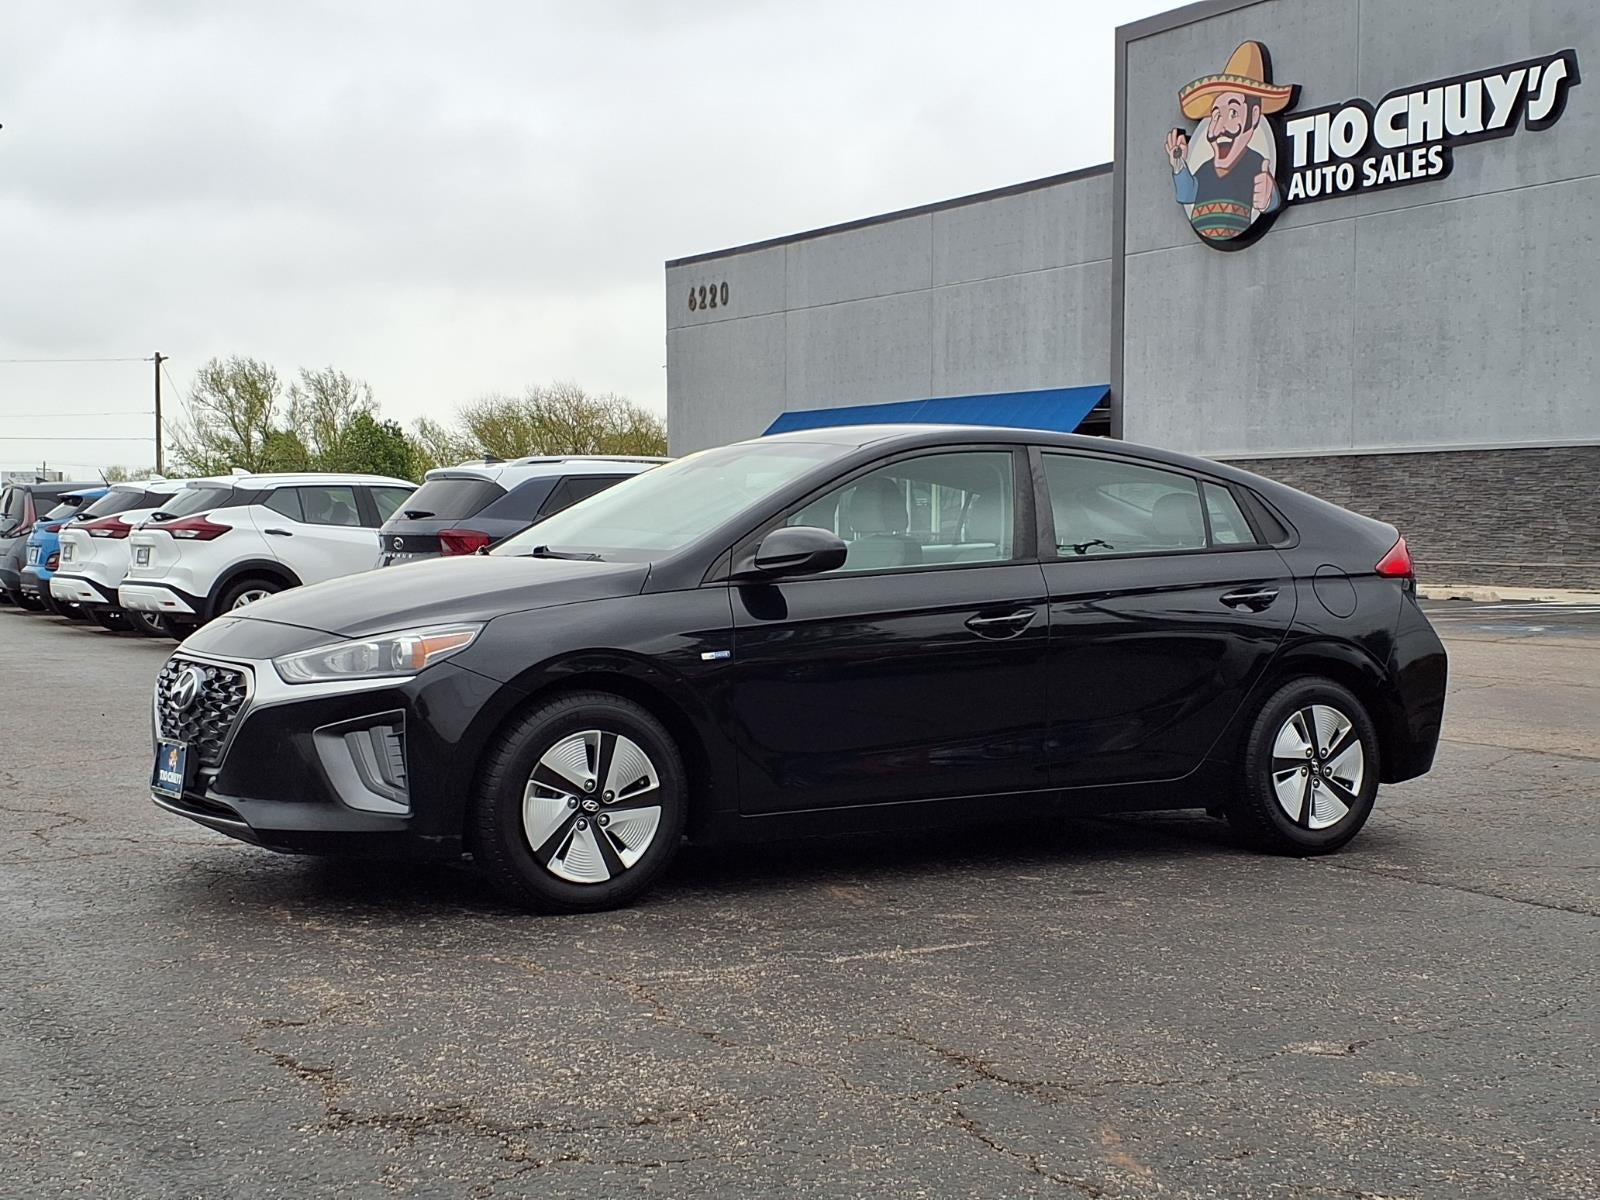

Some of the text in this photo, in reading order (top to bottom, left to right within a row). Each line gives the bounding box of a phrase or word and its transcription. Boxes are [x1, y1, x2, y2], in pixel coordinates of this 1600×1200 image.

[1287, 58, 1567, 168] TIO CHUY'S
[1287, 145, 1443, 201] AUTO SALES
[688, 281, 729, 312] 6220
